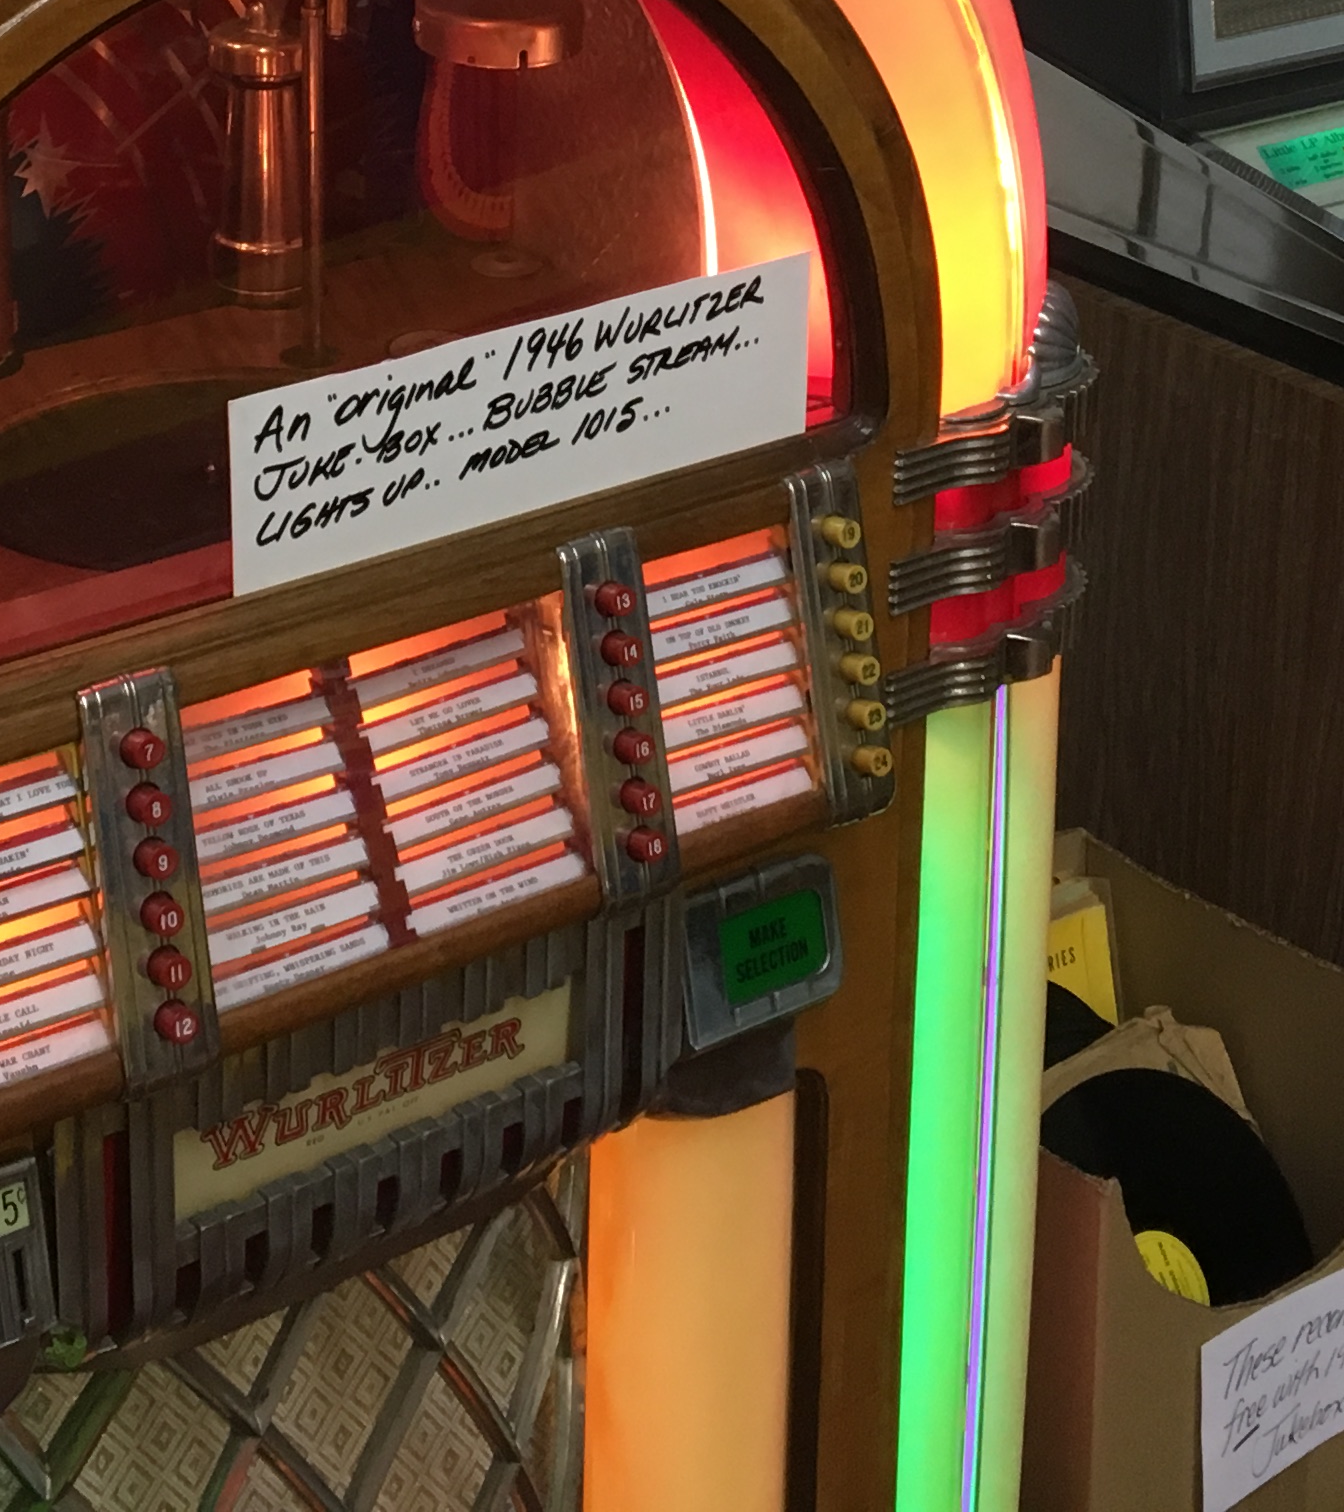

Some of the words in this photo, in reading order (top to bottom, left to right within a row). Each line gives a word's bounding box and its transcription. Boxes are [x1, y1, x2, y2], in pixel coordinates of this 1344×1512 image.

[1260, 143, 1297, 159] Little
[1300, 137, 1318, 151] LP
[253, 397, 312, 453] An
[502, 318, 585, 382] 1946
[593, 274, 766, 354] WURLITZER
[483, 361, 616, 430] BUBBLE
[255, 490, 372, 547] LIGHTS
[458, 430, 560, 482] MODEL
[842, 526, 855, 542] 19
[849, 571, 864, 588] 20
[616, 592, 631, 610] 13
[856, 618, 869, 636] 21
[623, 643, 638, 661] 14
[862, 662, 876, 678] 22
[630, 693, 644, 710] 15
[868, 708, 882, 726] 23
[144, 742, 155, 761] 7
[636, 741, 650, 758] 16
[874, 754, 888, 771] 24
[17, 794, 23, 802] I
[28, 786, 51, 798] LOVE
[642, 792, 656, 811] 17
[151, 800, 162, 819] 8
[648, 838, 662, 856] 18
[158, 854, 169, 872] 9
[159, 910, 178, 930] 10
[748, 916, 787, 948] MAKE
[25, 942, 54, 959] NIGHT
[736, 935, 809, 984] SELECTION
[170, 964, 184, 983] 11
[14, 1004, 39, 1018] CALL
[175, 1017, 193, 1038] 12
[22, 1044, 51, 1061] CHANT
[200, 1016, 525, 1170] WURLITZER
[1223, 1337, 1287, 1400] These
[1221, 1394, 1268, 1458] free
[1272, 1350, 1321, 1409] with
